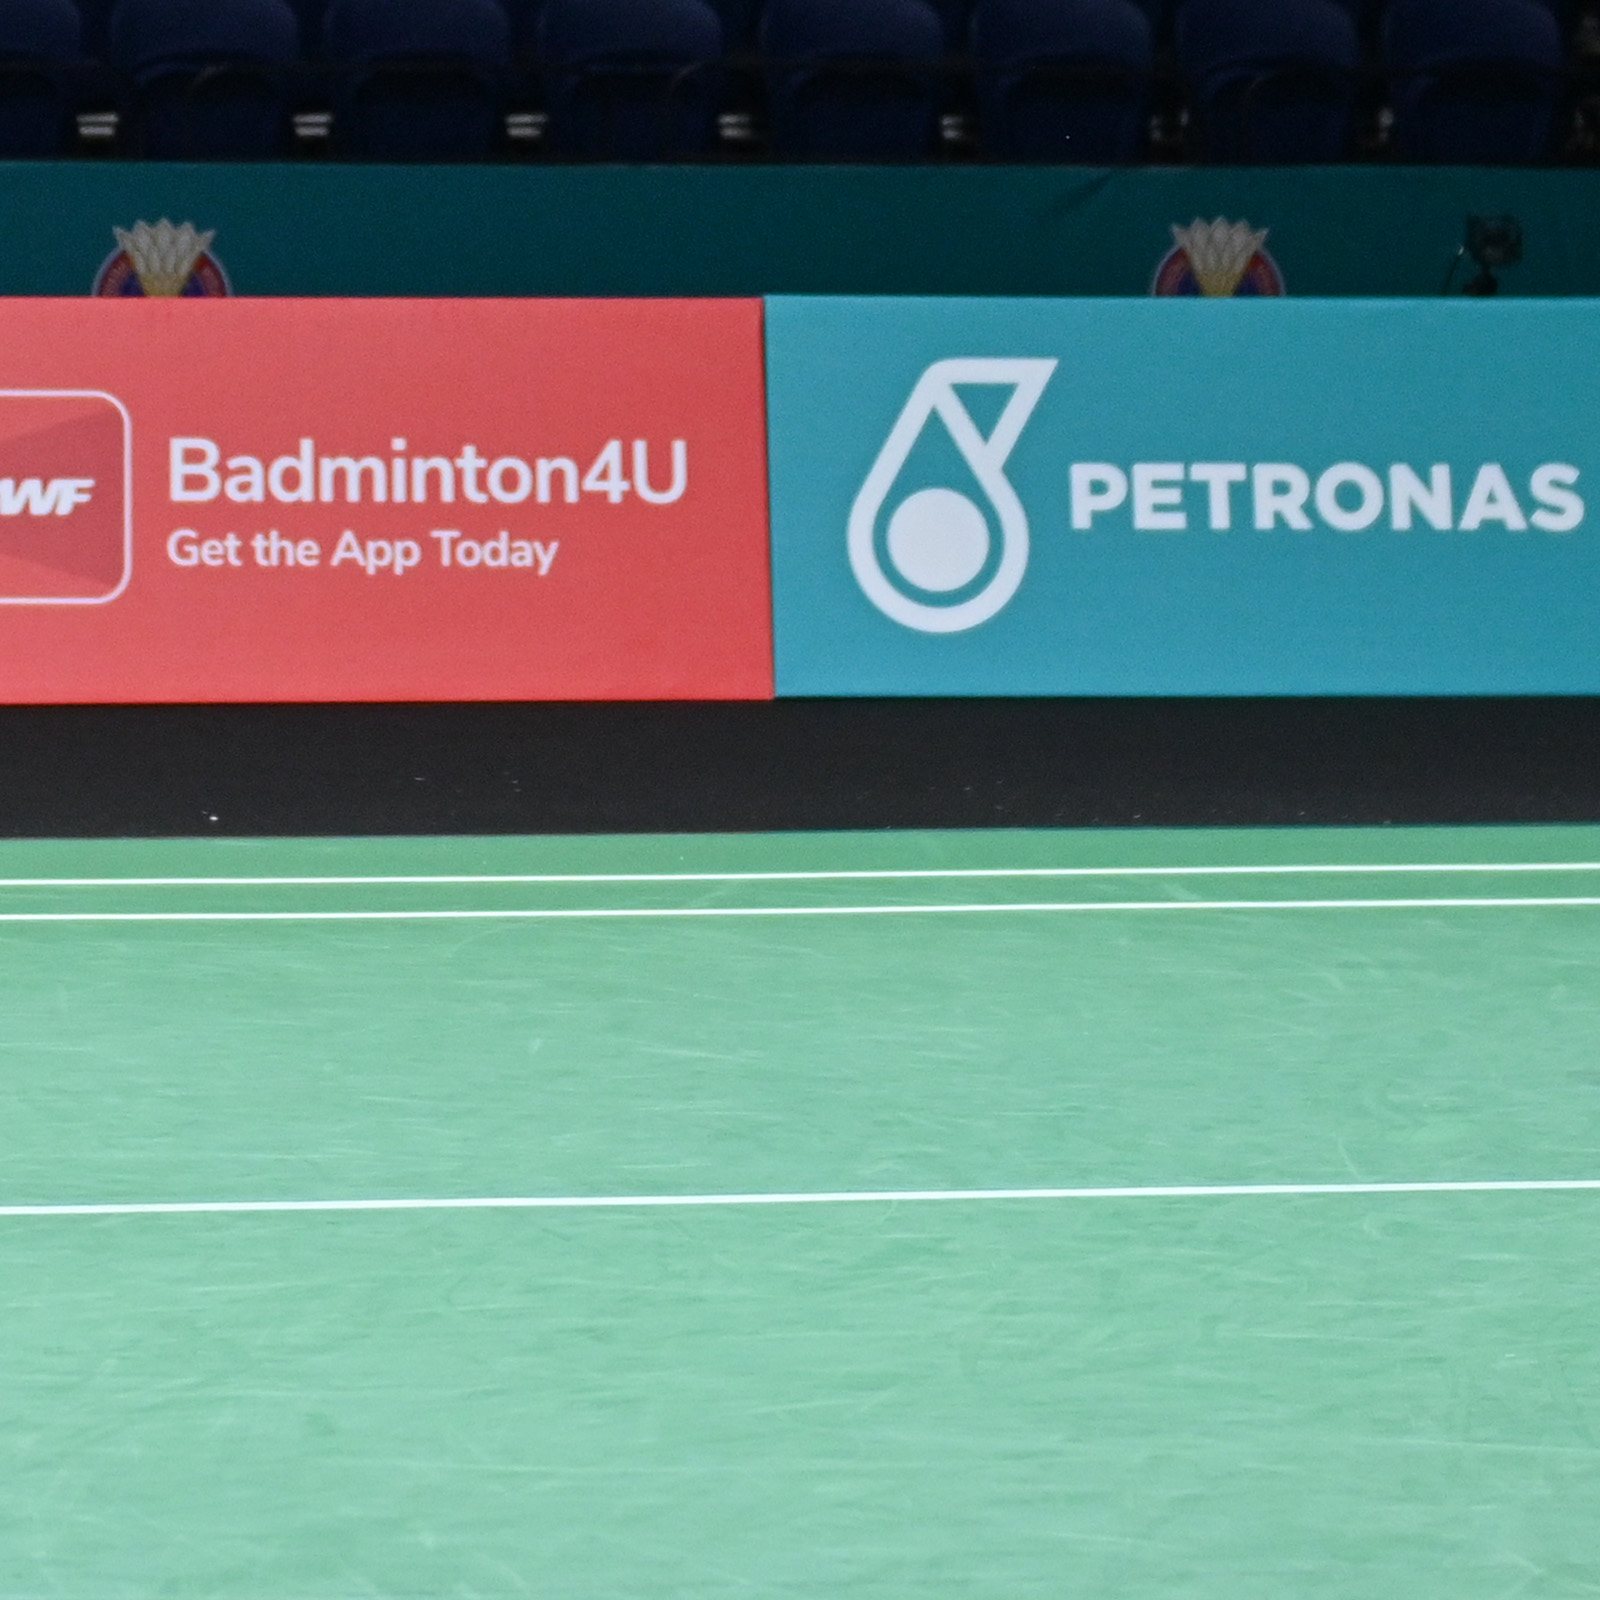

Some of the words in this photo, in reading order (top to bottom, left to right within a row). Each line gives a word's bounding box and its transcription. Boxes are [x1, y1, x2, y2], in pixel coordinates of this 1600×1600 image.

[168, 437, 689, 505] Badminton4U
[1069, 461, 1587, 533] PETRONAS
[166, 529, 242, 567] Get
[251, 530, 320, 567] the
[331, 530, 422, 576] App
[431, 530, 559, 576] Today
